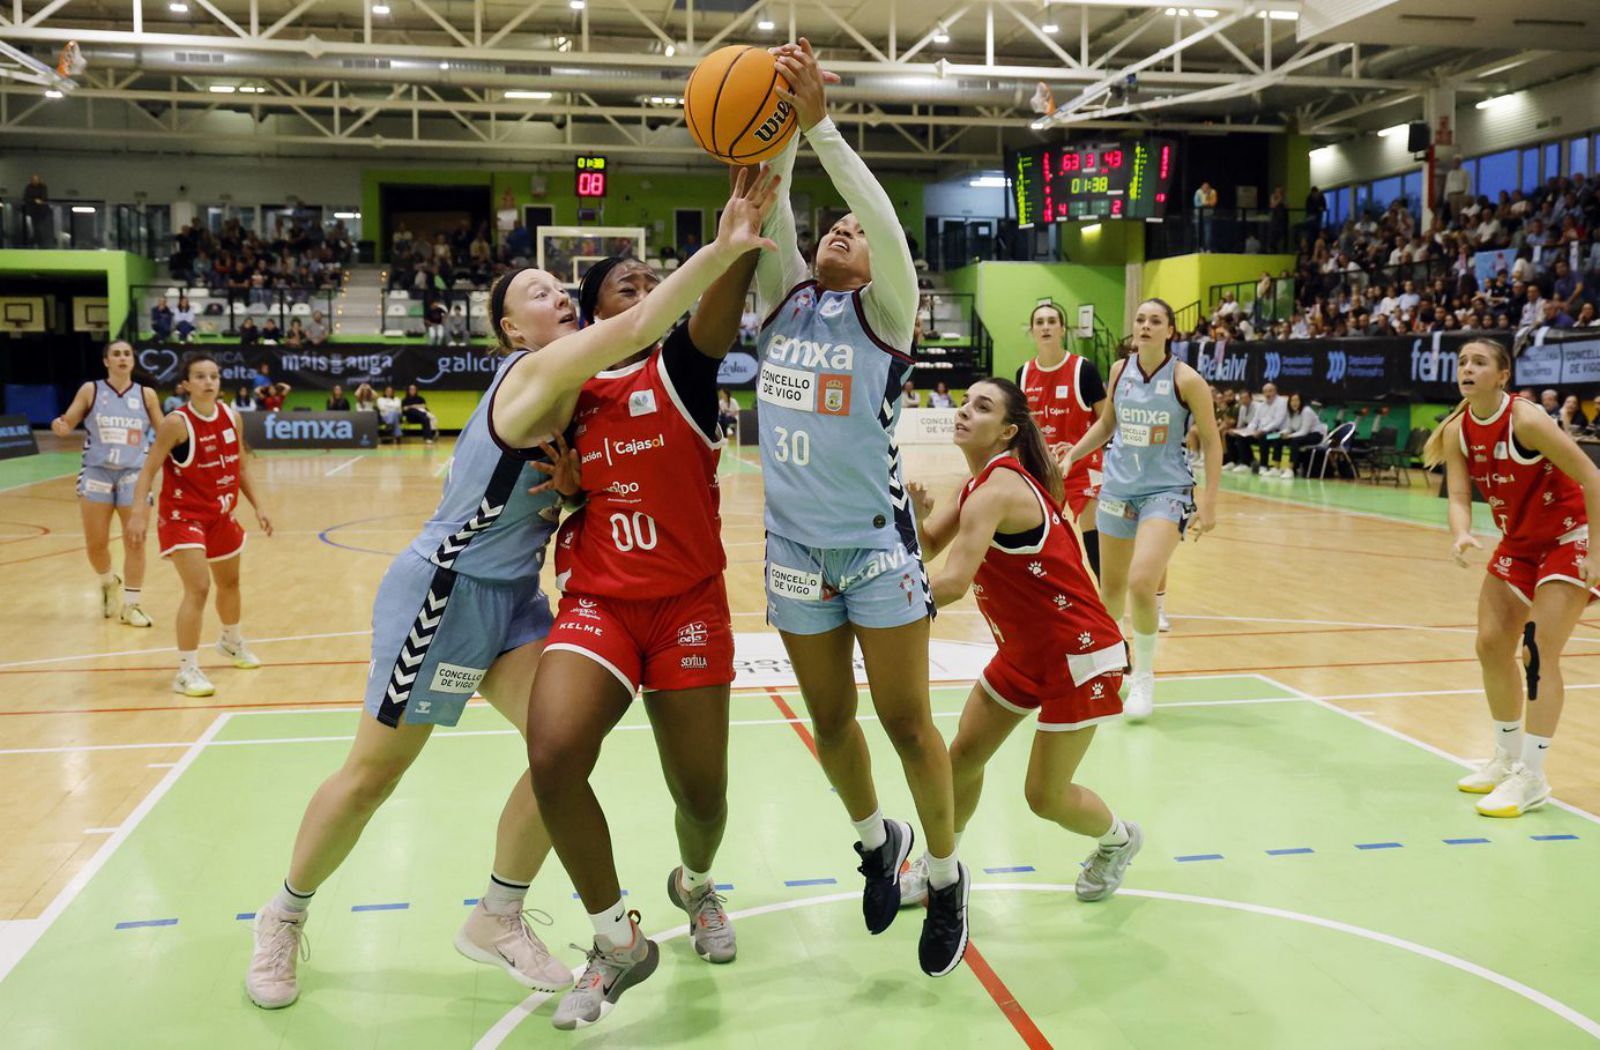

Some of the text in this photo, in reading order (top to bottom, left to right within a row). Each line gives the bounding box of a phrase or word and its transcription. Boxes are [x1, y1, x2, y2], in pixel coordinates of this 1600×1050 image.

[754, 100, 795, 142] Wil
[1063, 154, 1080, 170] 63
[1104, 150, 1122, 167] 43
[578, 173, 604, 196] 08
[1071, 176, 1108, 194] 01:38
[1058, 203, 1068, 216] 4
[1112, 199, 1122, 214] 2
[767, 332, 854, 370] emxa
[1411, 338, 1458, 382] fem
[220, 365, 257, 379] elta
[1199, 352, 1248, 381] Realvi
[762, 369, 810, 390] CONCELLO
[763, 383, 802, 402] DE VIGO
[96, 413, 143, 427] femxa
[265, 414, 353, 440] femxa
[921, 417, 955, 425] CONCEL
[613, 433, 665, 456] Cajasol
[774, 426, 810, 467] 30
[610, 511, 657, 552] 00
[774, 579, 810, 595] DE VIGO
[559, 622, 603, 636] KELME
[681, 654, 708, 667] SEVILLA
[439, 668, 482, 681] CONCELLO
[441, 678, 474, 688] DE VIGO
